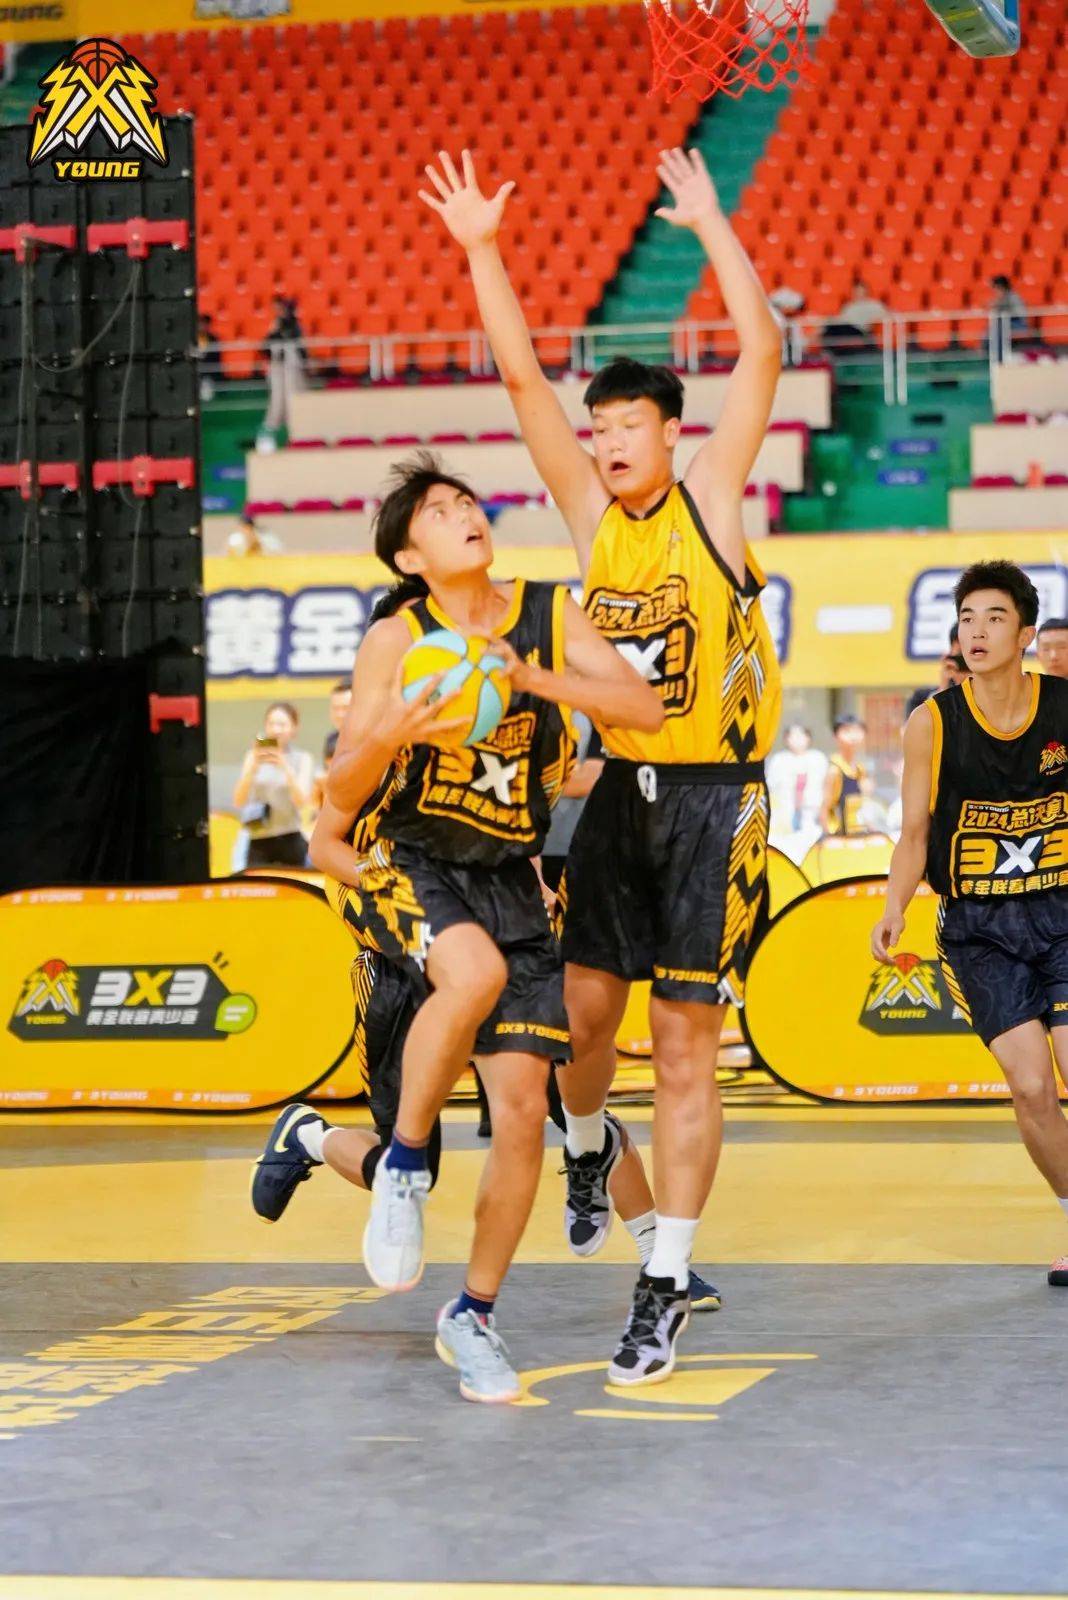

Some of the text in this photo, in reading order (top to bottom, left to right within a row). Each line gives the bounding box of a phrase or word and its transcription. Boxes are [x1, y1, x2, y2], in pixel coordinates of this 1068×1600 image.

[207, 591, 388, 673] 黄金
[959, 832, 1068, 876] 3X3
[90, 970, 208, 1006] 3X3
[880, 1009, 927, 1020] YOUNG
